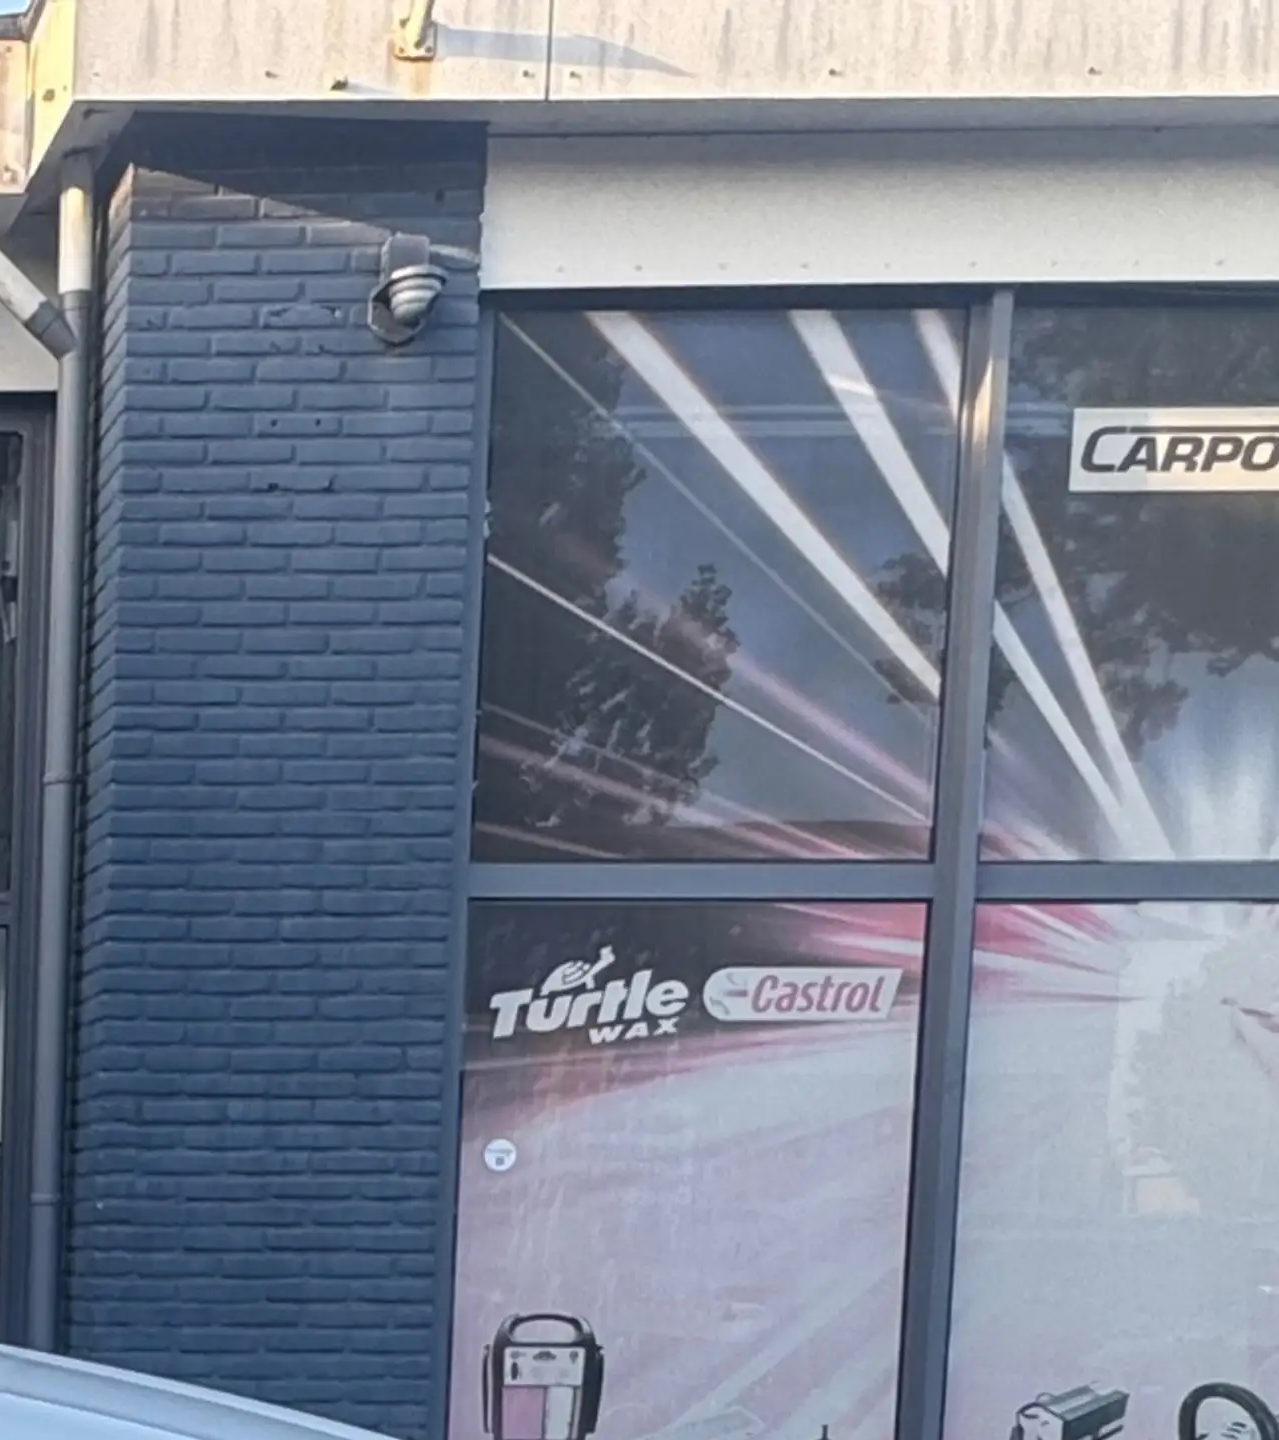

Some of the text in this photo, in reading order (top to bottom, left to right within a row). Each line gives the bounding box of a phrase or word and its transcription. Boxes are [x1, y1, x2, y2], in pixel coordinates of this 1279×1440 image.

[489, 969, 689, 1039] Turtle
[750, 974, 885, 1015] Castrol
[589, 1018, 680, 1046] WAX
